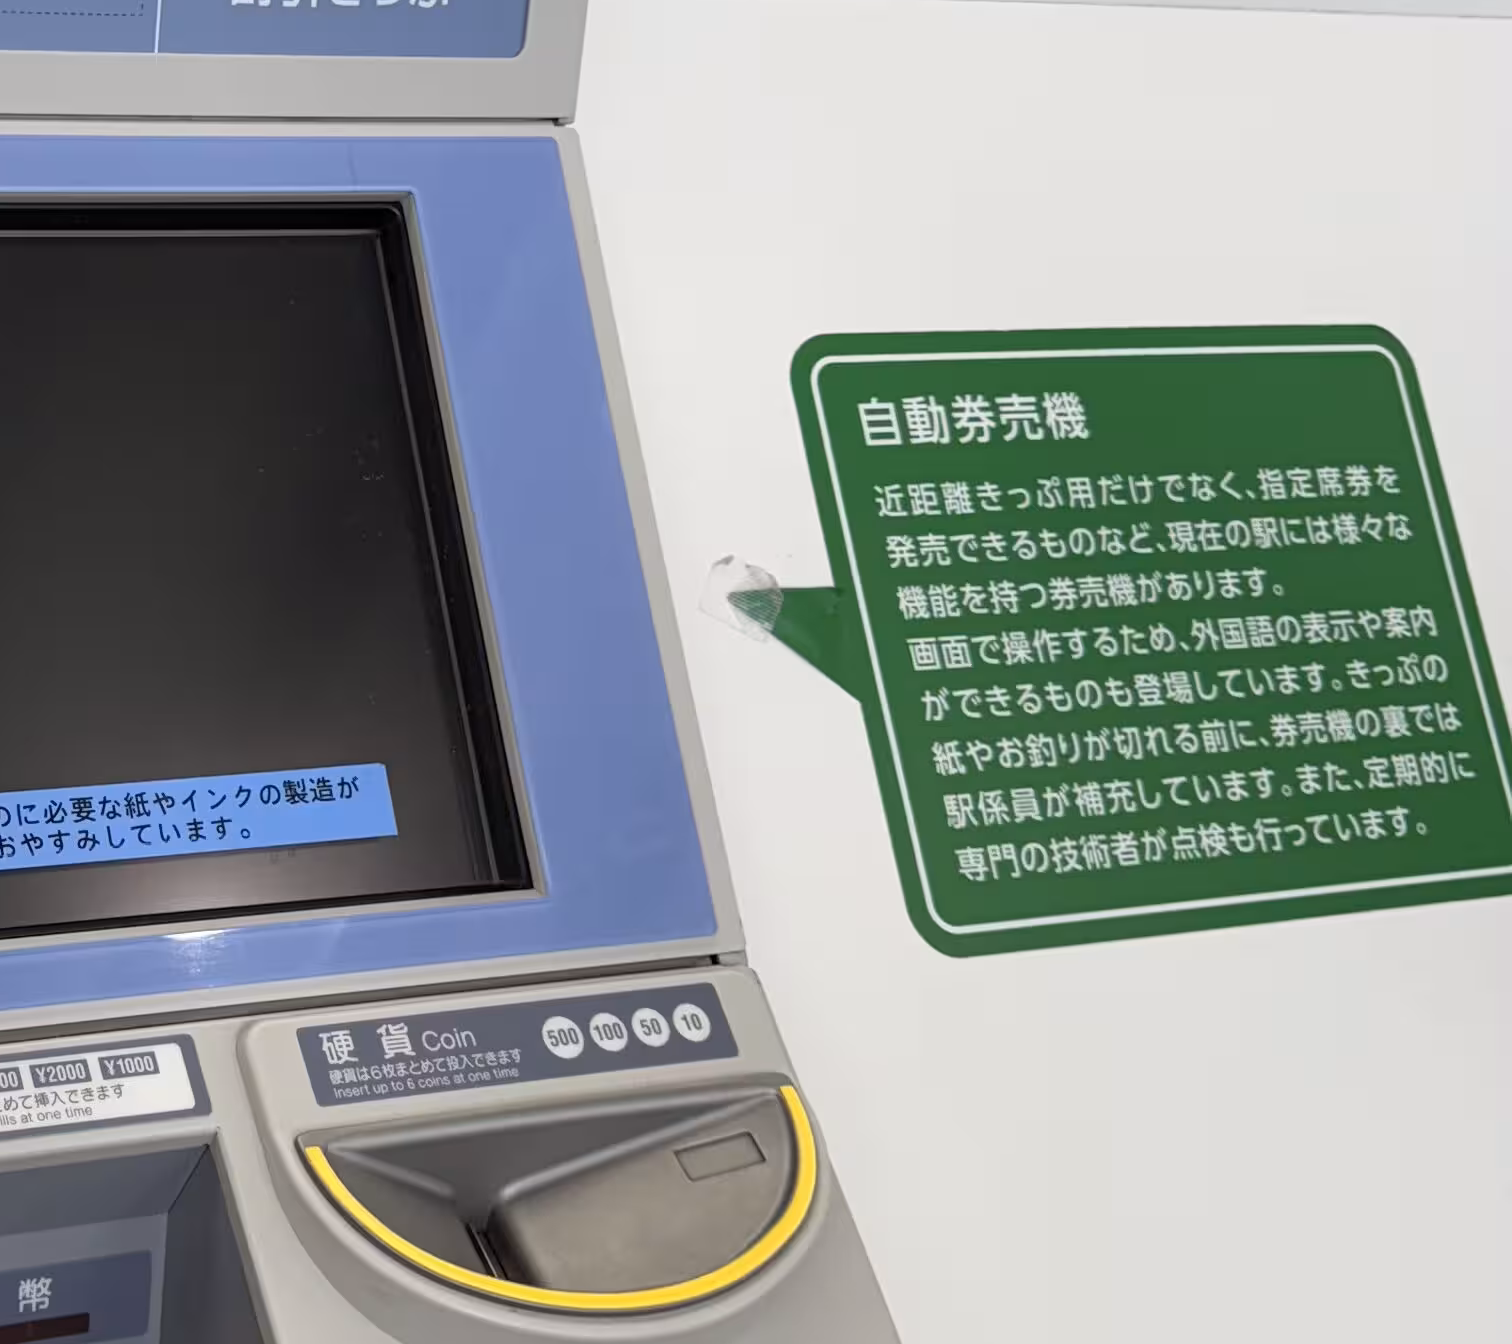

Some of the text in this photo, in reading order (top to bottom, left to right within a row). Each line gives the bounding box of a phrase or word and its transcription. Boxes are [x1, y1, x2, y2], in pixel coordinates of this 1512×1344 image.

[857, 390, 1090, 447] 自動券売機
[896, 567, 1285, 621] 機能を持つ券売機があります。
[319, 1022, 477, 1065] 硬貨 Coin
[547, 1012, 702, 1047] 500 100 50 10
[35, 1062, 87, 1084] ¥2000
[104, 1055, 154, 1076] ¥1000
[334, 1084, 371, 1099] Insert
[373, 1083, 389, 1095] up
[391, 1079, 404, 1091] to
[418, 1075, 451, 1088] coins
[454, 1074, 466, 1084] at
[468, 1071, 491, 1082] one
[493, 1067, 519, 1079] time
[20, 1112, 33, 1125] at
[37, 1109, 61, 1123] one
[66, 1105, 93, 1119] time
